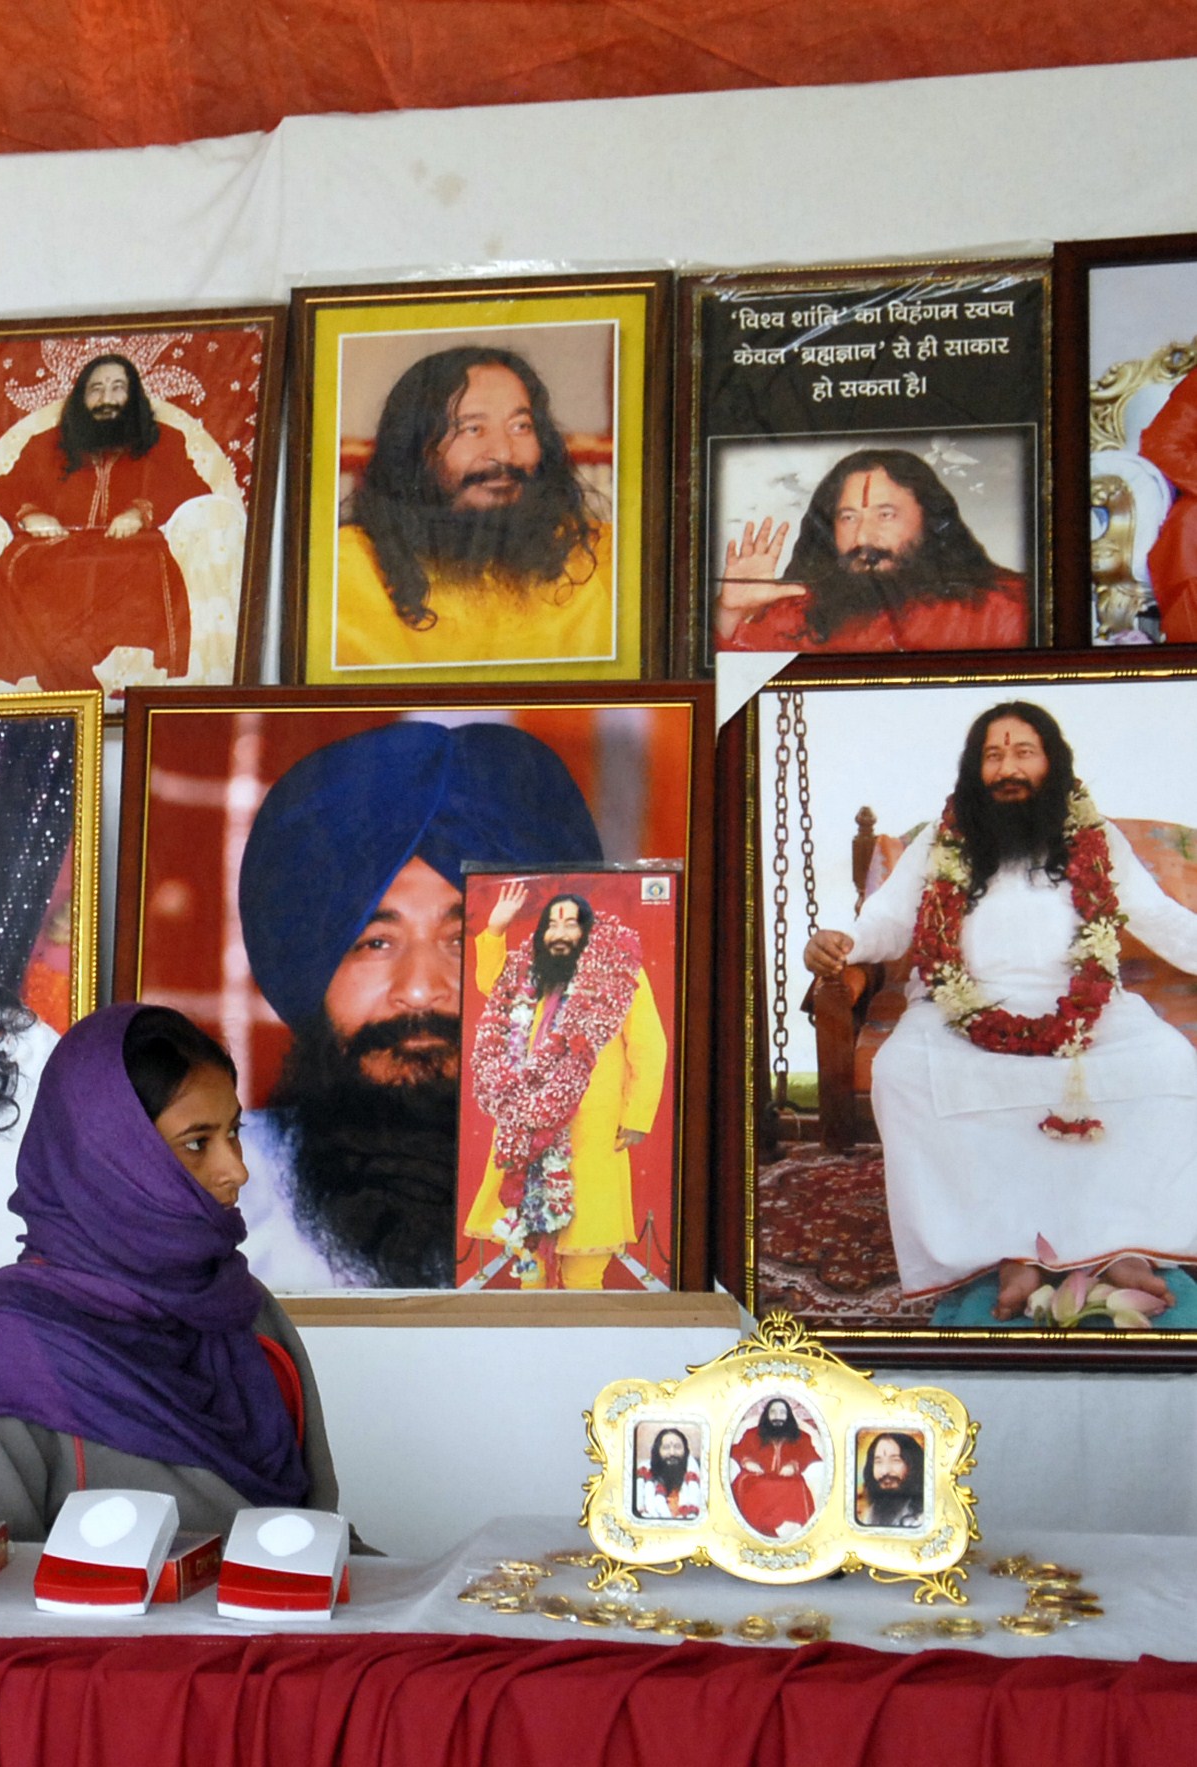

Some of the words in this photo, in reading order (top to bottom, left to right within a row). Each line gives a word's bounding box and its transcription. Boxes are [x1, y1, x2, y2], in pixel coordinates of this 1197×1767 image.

[854, 306, 882, 324] का
[887, 300, 959, 325] विहंगम
[963, 300, 1015, 319] स्वप्न
[733, 343, 786, 366] केवल
[892, 335, 911, 359] से
[917, 334, 938, 361] ही
[944, 337, 1010, 356] साकार
[812, 375, 833, 402] हो
[839, 378, 900, 398] सकता
[903, 371, 927, 398] है।
